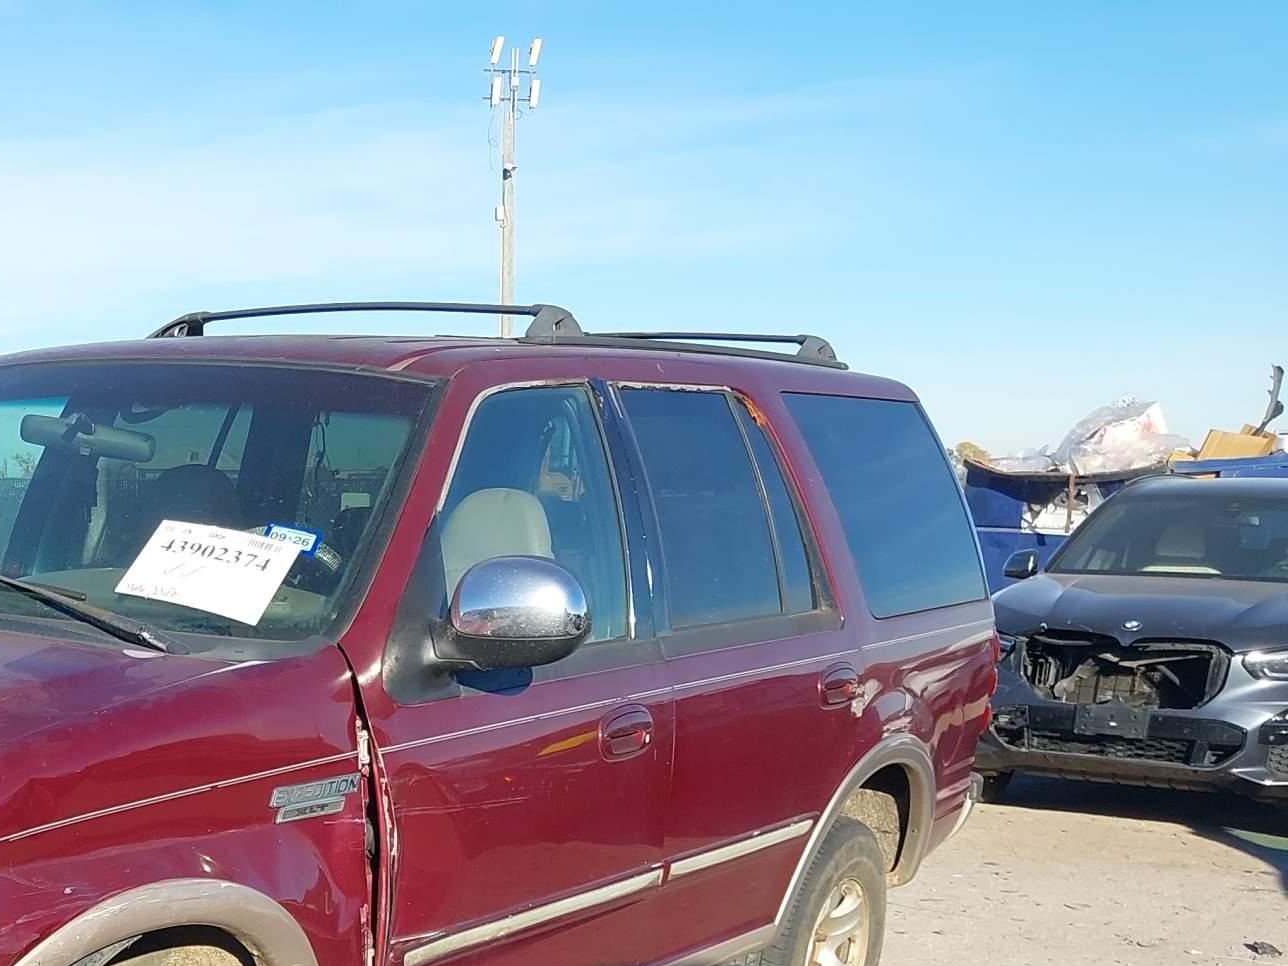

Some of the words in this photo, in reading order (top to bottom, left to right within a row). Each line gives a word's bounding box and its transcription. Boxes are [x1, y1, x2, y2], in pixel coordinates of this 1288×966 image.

[160, 539, 271, 572] 43902374
[274, 776, 359, 805] EXPEDITION
[295, 804, 329, 816] XLT
